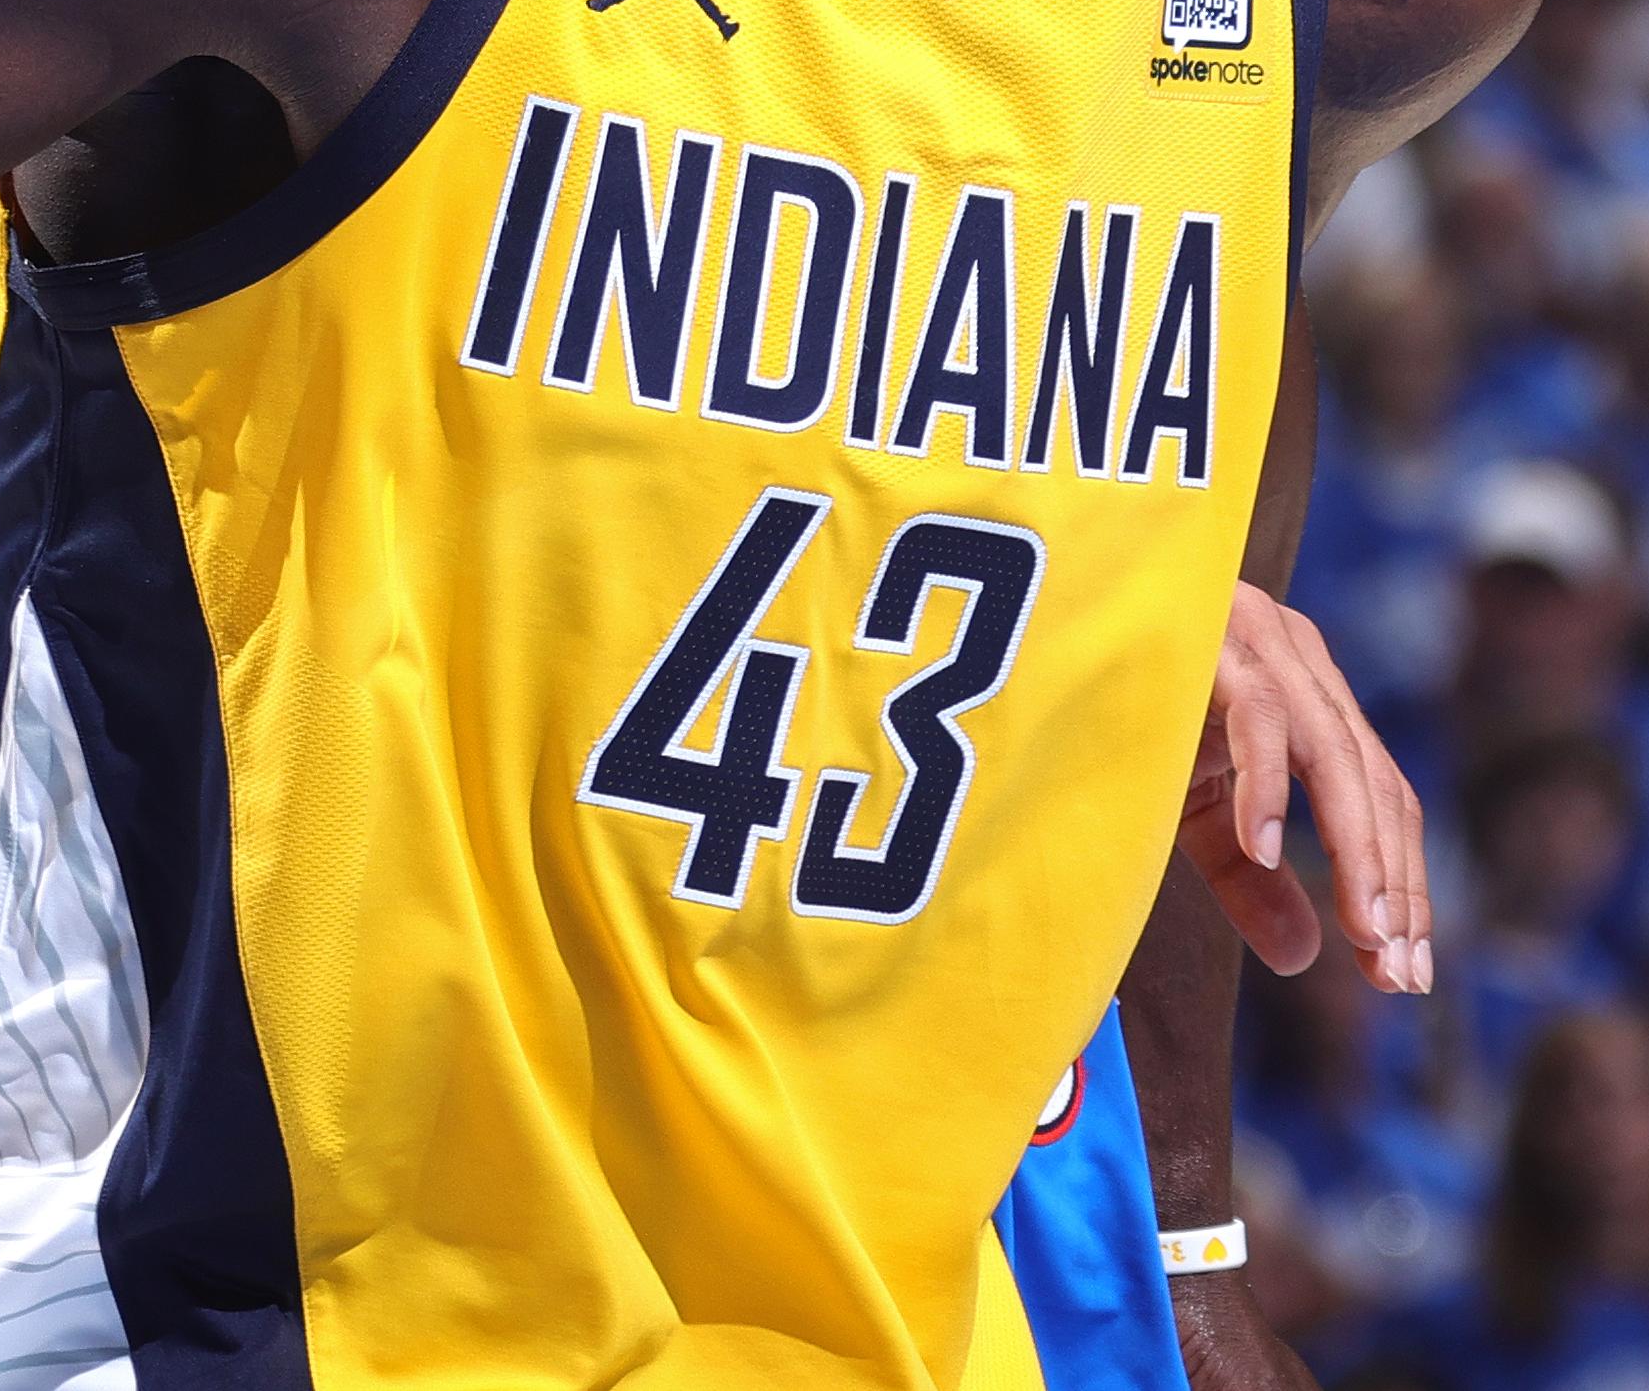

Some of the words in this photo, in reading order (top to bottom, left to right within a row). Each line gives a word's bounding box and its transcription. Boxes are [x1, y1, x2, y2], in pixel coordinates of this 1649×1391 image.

[1150, 51, 1264, 87] spokenote
[459, 94, 1220, 489] INDIANA
[576, 485, 1047, 926] 43
